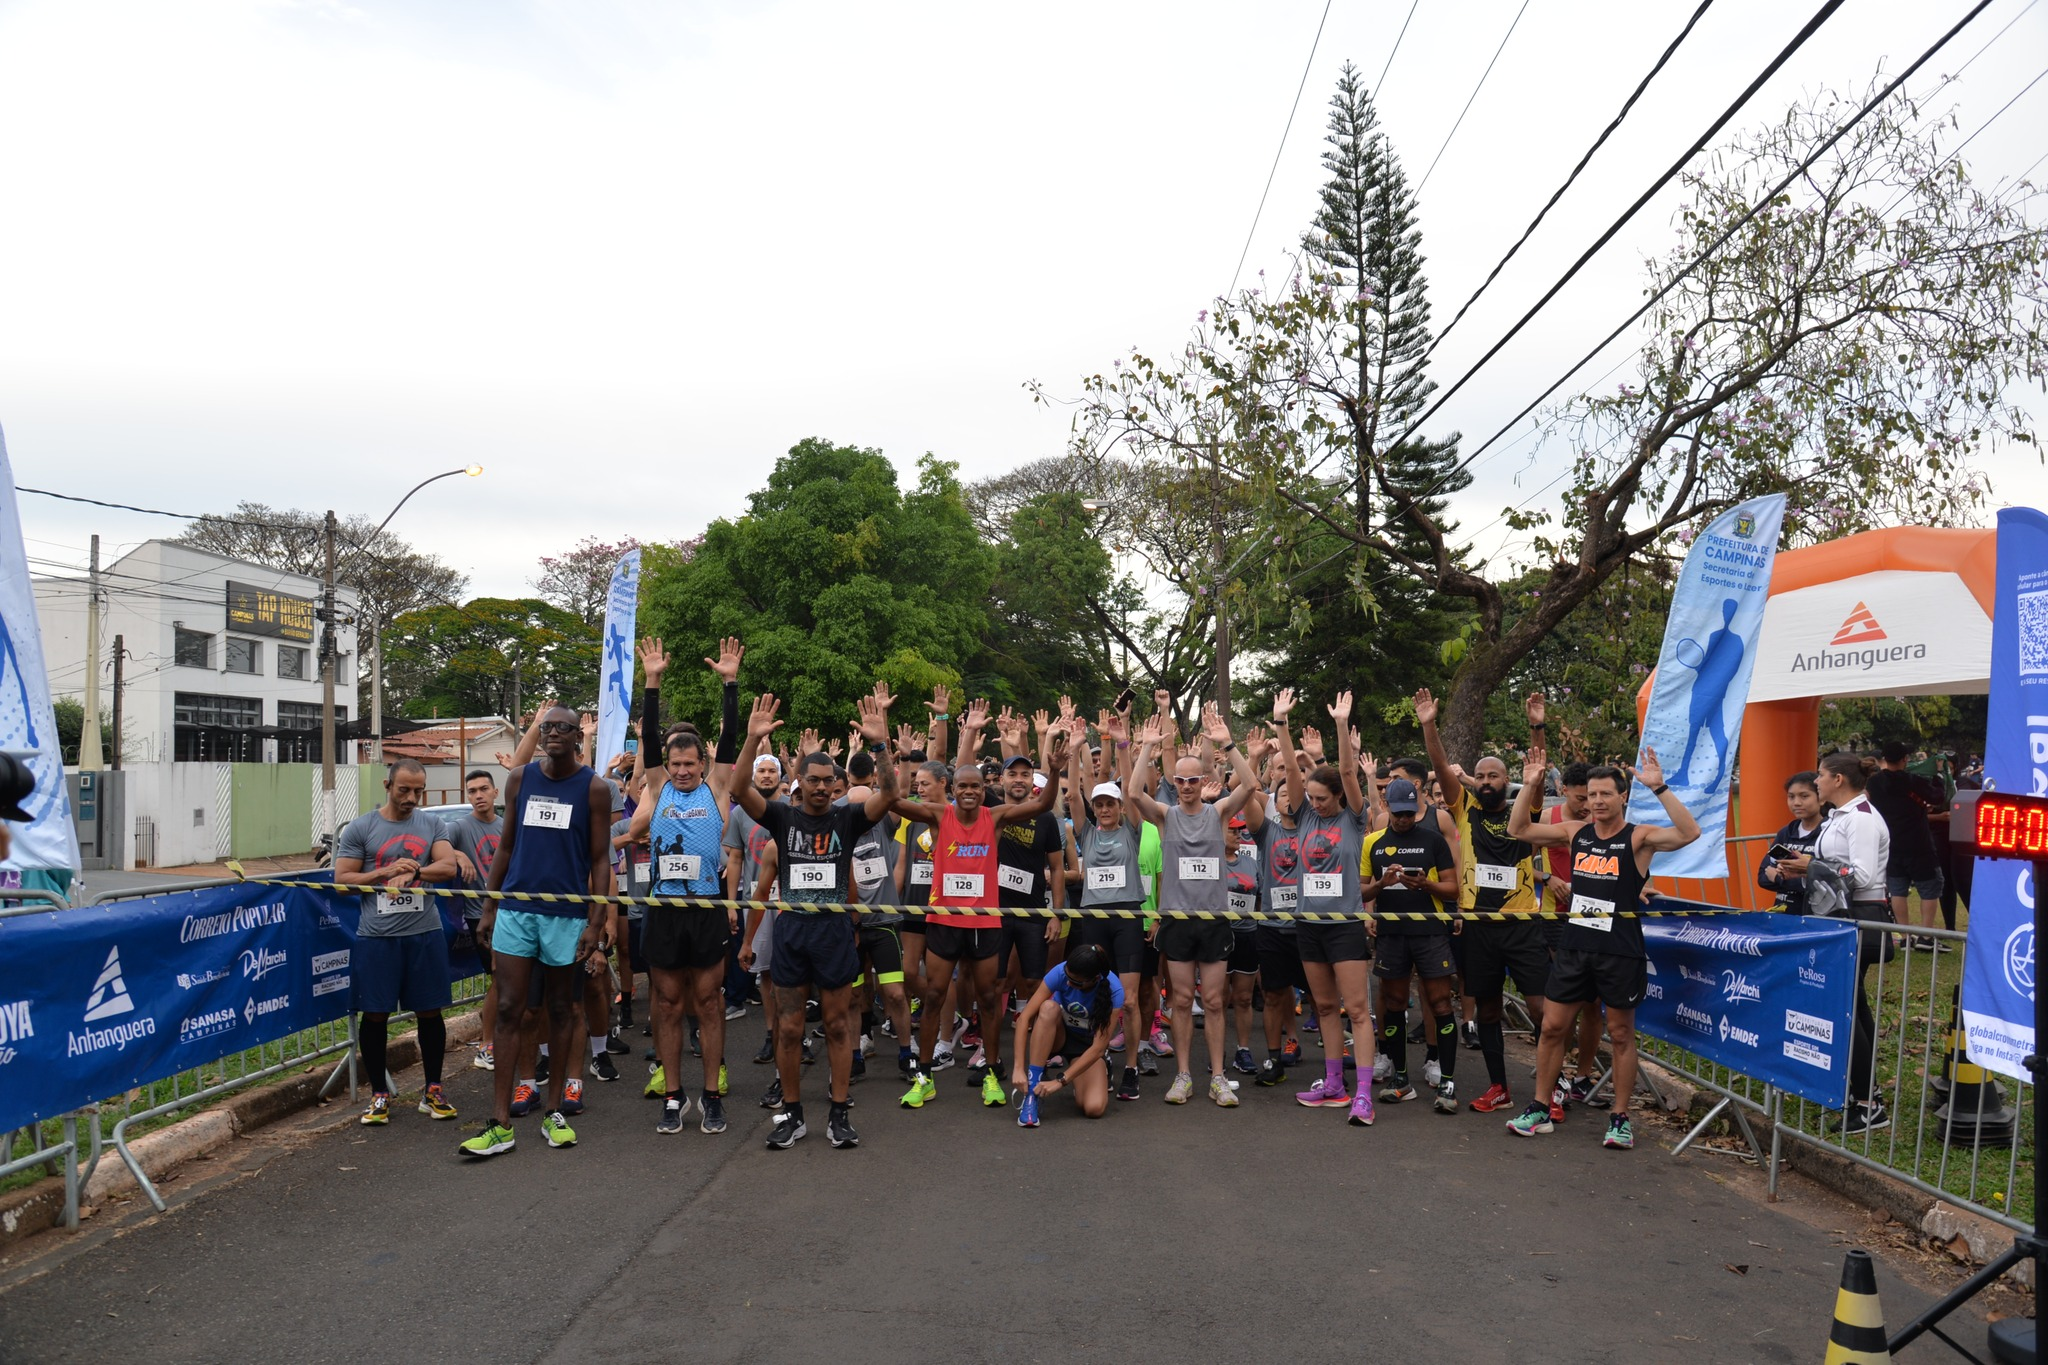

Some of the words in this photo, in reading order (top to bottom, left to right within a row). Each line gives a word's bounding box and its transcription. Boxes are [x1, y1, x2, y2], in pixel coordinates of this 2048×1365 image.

[1707, 534, 1759, 554] PREFEITURA
[1760, 545, 1770, 556] DE
[1705, 546, 1766, 569] CAMPINAS
[1703, 561, 1746, 579] Secretaria
[1701, 573, 1736, 589] Esportes
[256, 591, 278, 623] TAP
[280, 596, 313, 631] HOUSE
[1791, 643, 1926, 672] Anhanguera
[539, 810, 557, 821] 191
[1978, 804, 2048, 851] 00:0
[956, 845, 990, 857] RUN
[1375, 848, 1385, 856] EU
[668, 862, 689, 872] 256
[864, 866, 872, 875] 8
[1192, 864, 1207, 873] 112
[802, 871, 823, 882] 190
[1008, 874, 1024, 885] 110
[1098, 873, 1115, 882] 219
[1487, 872, 1503, 882] 116
[955, 880, 973, 890] 128
[1314, 880, 1332, 890] 139
[389, 895, 413, 906] 209
[1230, 898, 1246, 908] 140
[1280, 892, 1297, 902] 138
[181, 912, 232, 944] CORREIO
[232, 902, 287, 932] POPULAR
[1675, 920, 1719, 948] CORREIO
[1711, 927, 1763, 957] POPULAR
[321, 955, 349, 971] CAMPINAS
[1798, 966, 1826, 983] PeRosa
[257, 994, 290, 1016] EMDEC
[189, 1007, 237, 1030] SANASA
[1682, 1006, 1713, 1026] SANASA
[180, 1019, 237, 1042] CAMPINAS
[1675, 1015, 1713, 1034] CAMPINAS
[1795, 1021, 1831, 1040] CAMPINAS
[68, 1017, 156, 1058] Anhanguera
[1730, 1026, 1760, 1048] EMDEC
[1984, 1046, 1995, 1056] no
